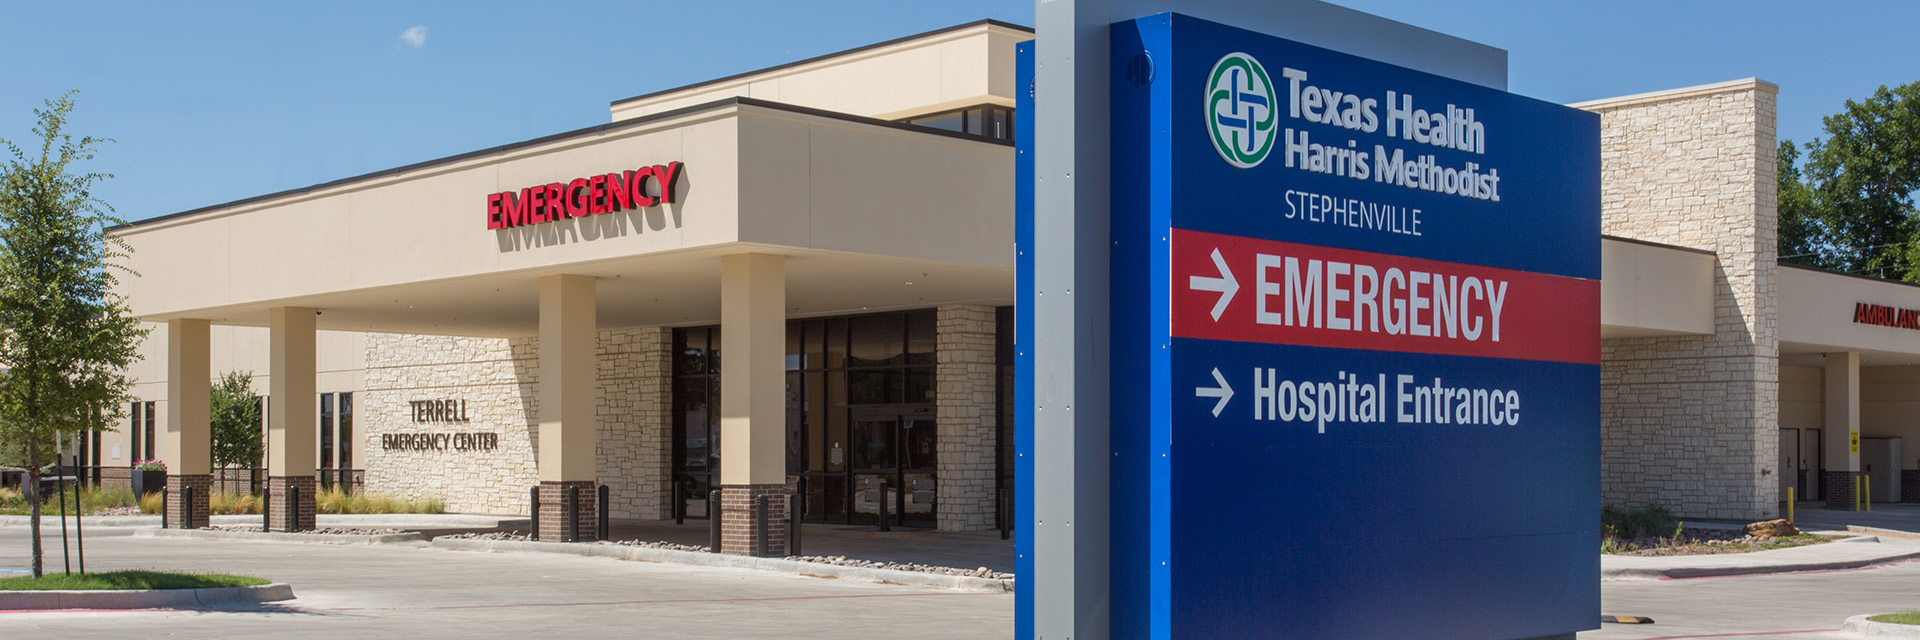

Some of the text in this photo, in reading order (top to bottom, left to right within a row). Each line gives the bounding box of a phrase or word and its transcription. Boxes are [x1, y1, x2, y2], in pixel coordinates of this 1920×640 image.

[1282, 67, 1485, 154] Texas Health
[487, 161, 684, 230] EMERGENCY
[1284, 128, 1500, 202] Harris Methodist
[1284, 189, 1422, 237] STEPHENVILLE
[1255, 252, 1508, 343] EMERGENCY
[409, 399, 469, 423] TERRELL
[1253, 366, 1520, 434] Hospital Entrance
[382, 432, 498, 452] EMERGENCY CENTER
